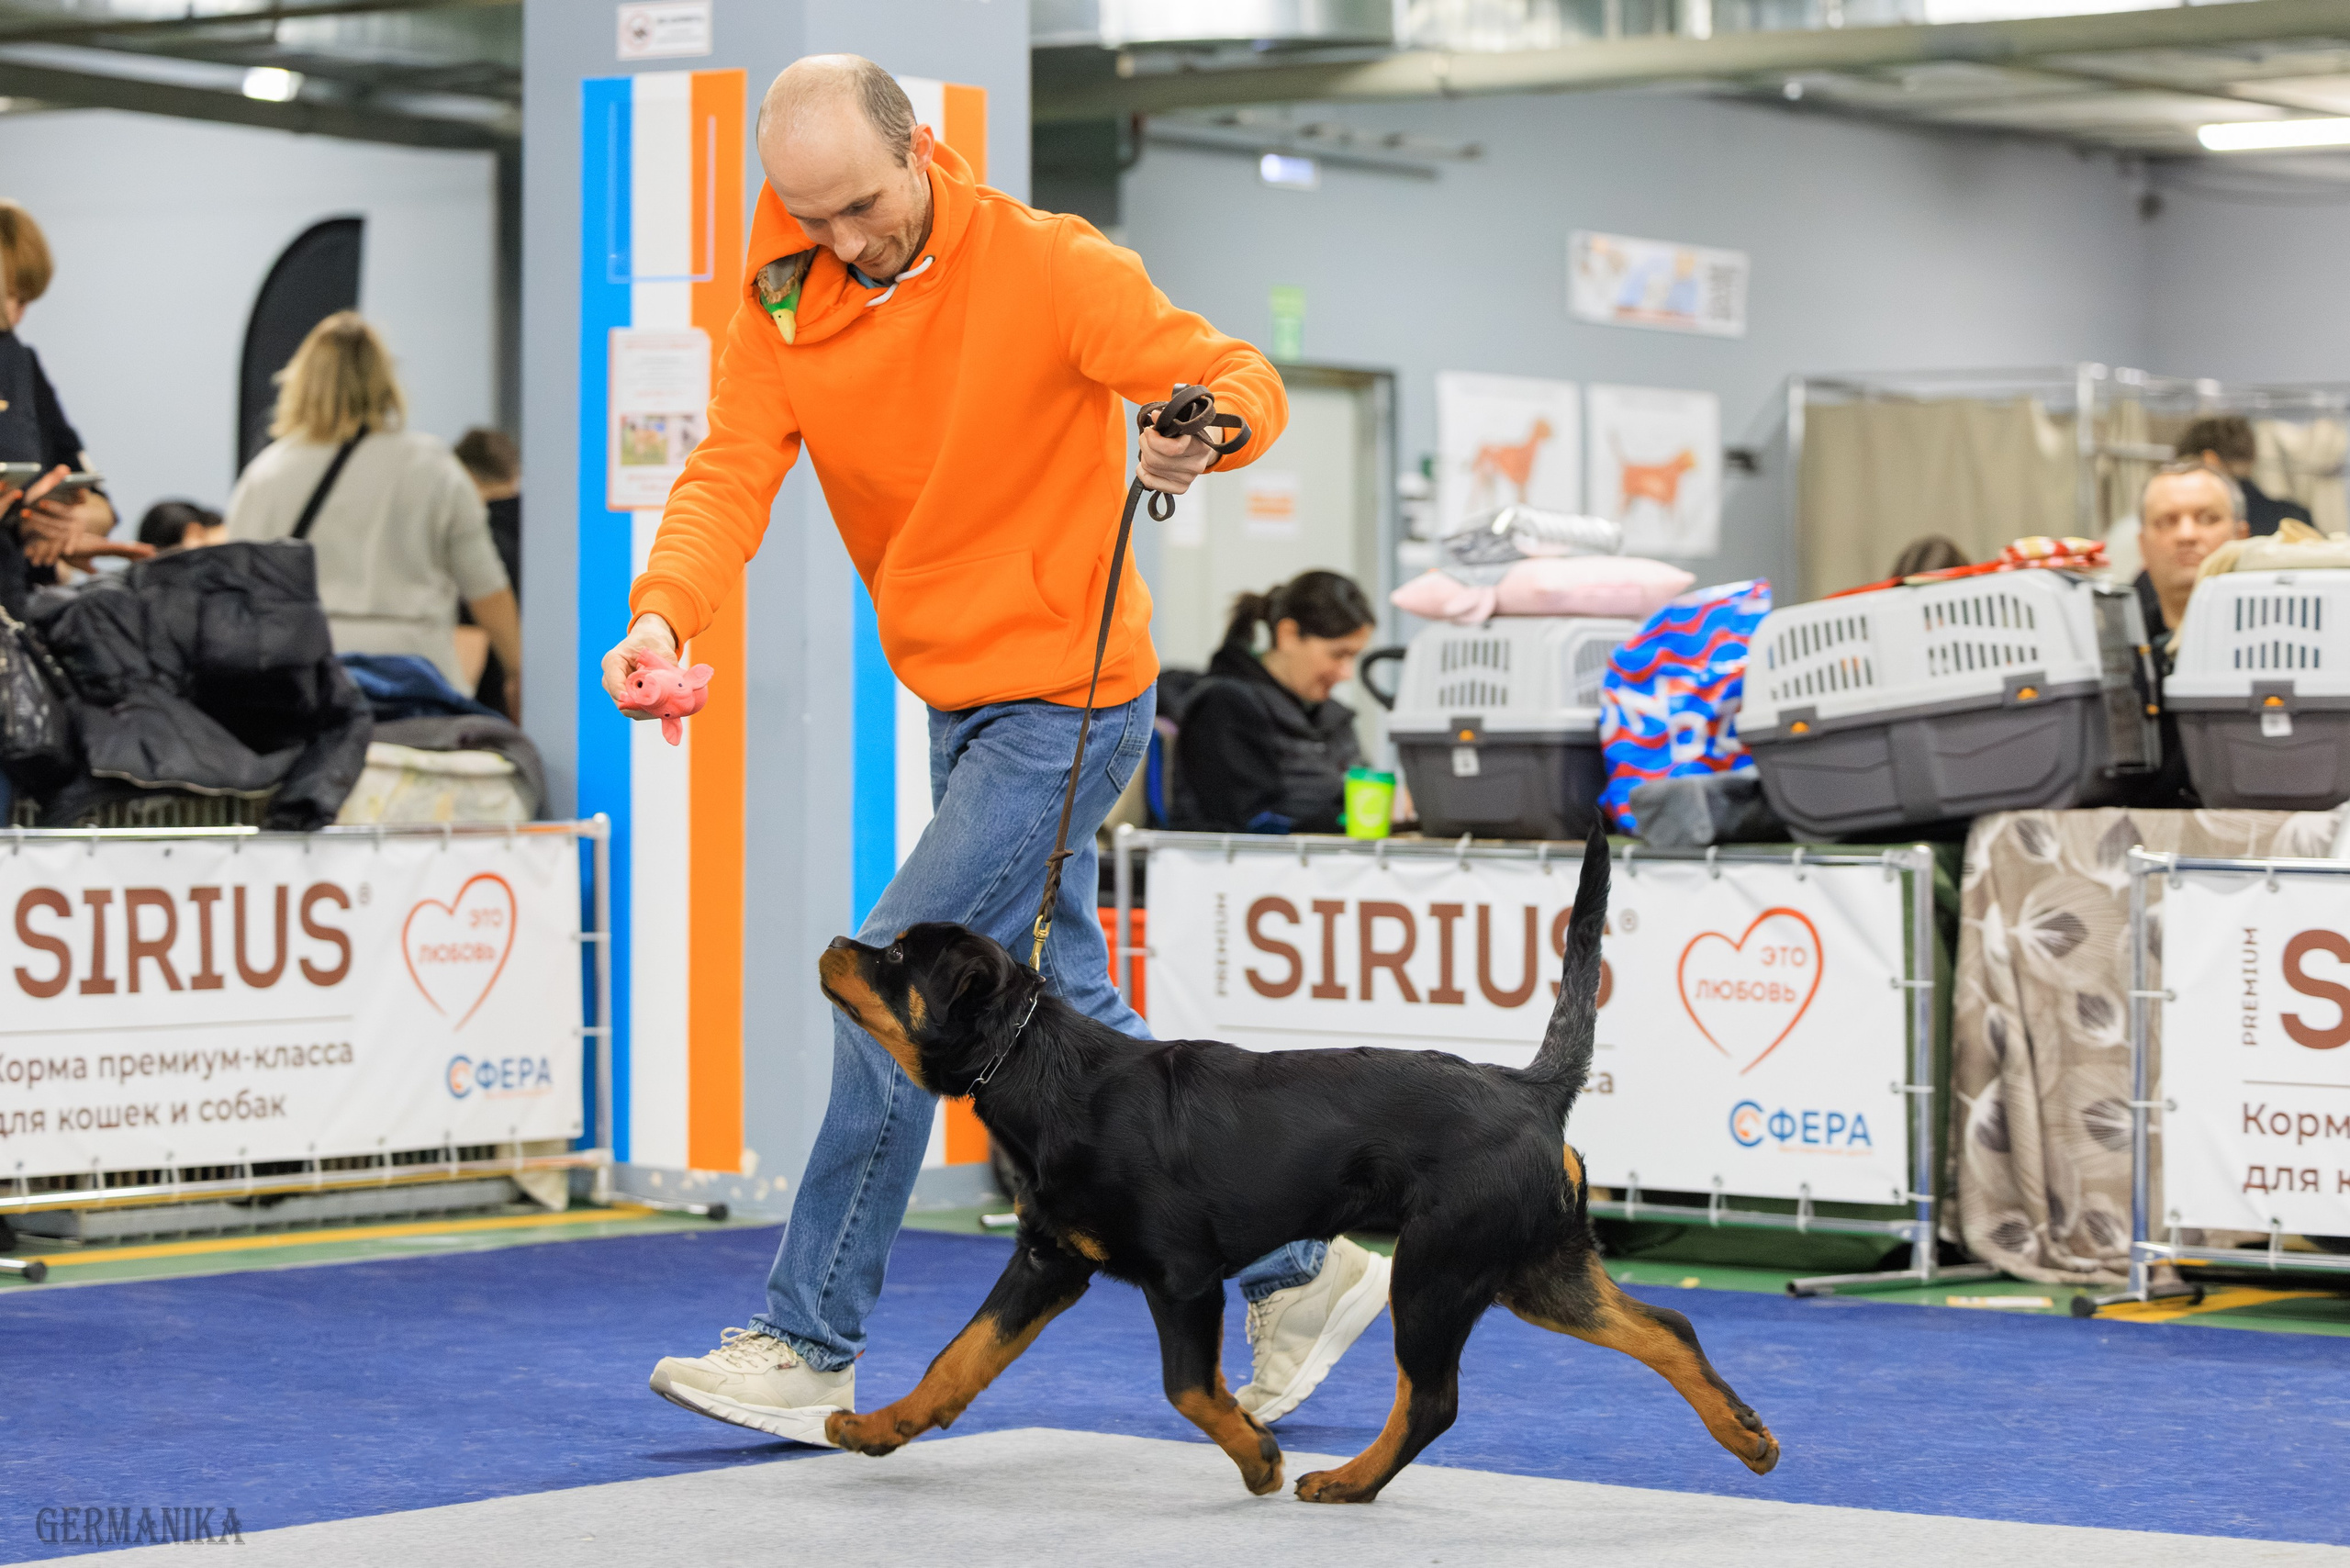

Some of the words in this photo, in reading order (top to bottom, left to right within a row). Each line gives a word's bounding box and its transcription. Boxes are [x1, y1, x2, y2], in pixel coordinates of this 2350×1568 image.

[13, 881, 353, 999] SIRIUS
[469, 908, 503, 929] ЭТО
[419, 942, 497, 964] ЛЮБОВЬ
[1761, 946, 1807, 968] ЭТО
[1695, 979, 1796, 1003] ЛЮБОВЬ
[2241, 926, 2259, 1047] PREMIUM
[0, 1054, 87, 1090] орма
[98, 1041, 353, 1085] премиум-класса
[445, 1053, 553, 1100] СФЕРА
[58, 1103, 161, 1132] кошек
[171, 1103, 188, 1125] и
[198, 1089, 286, 1123] собак
[1729, 1099, 1873, 1148] СФЕРА
[2242, 1164, 2320, 1196] для
